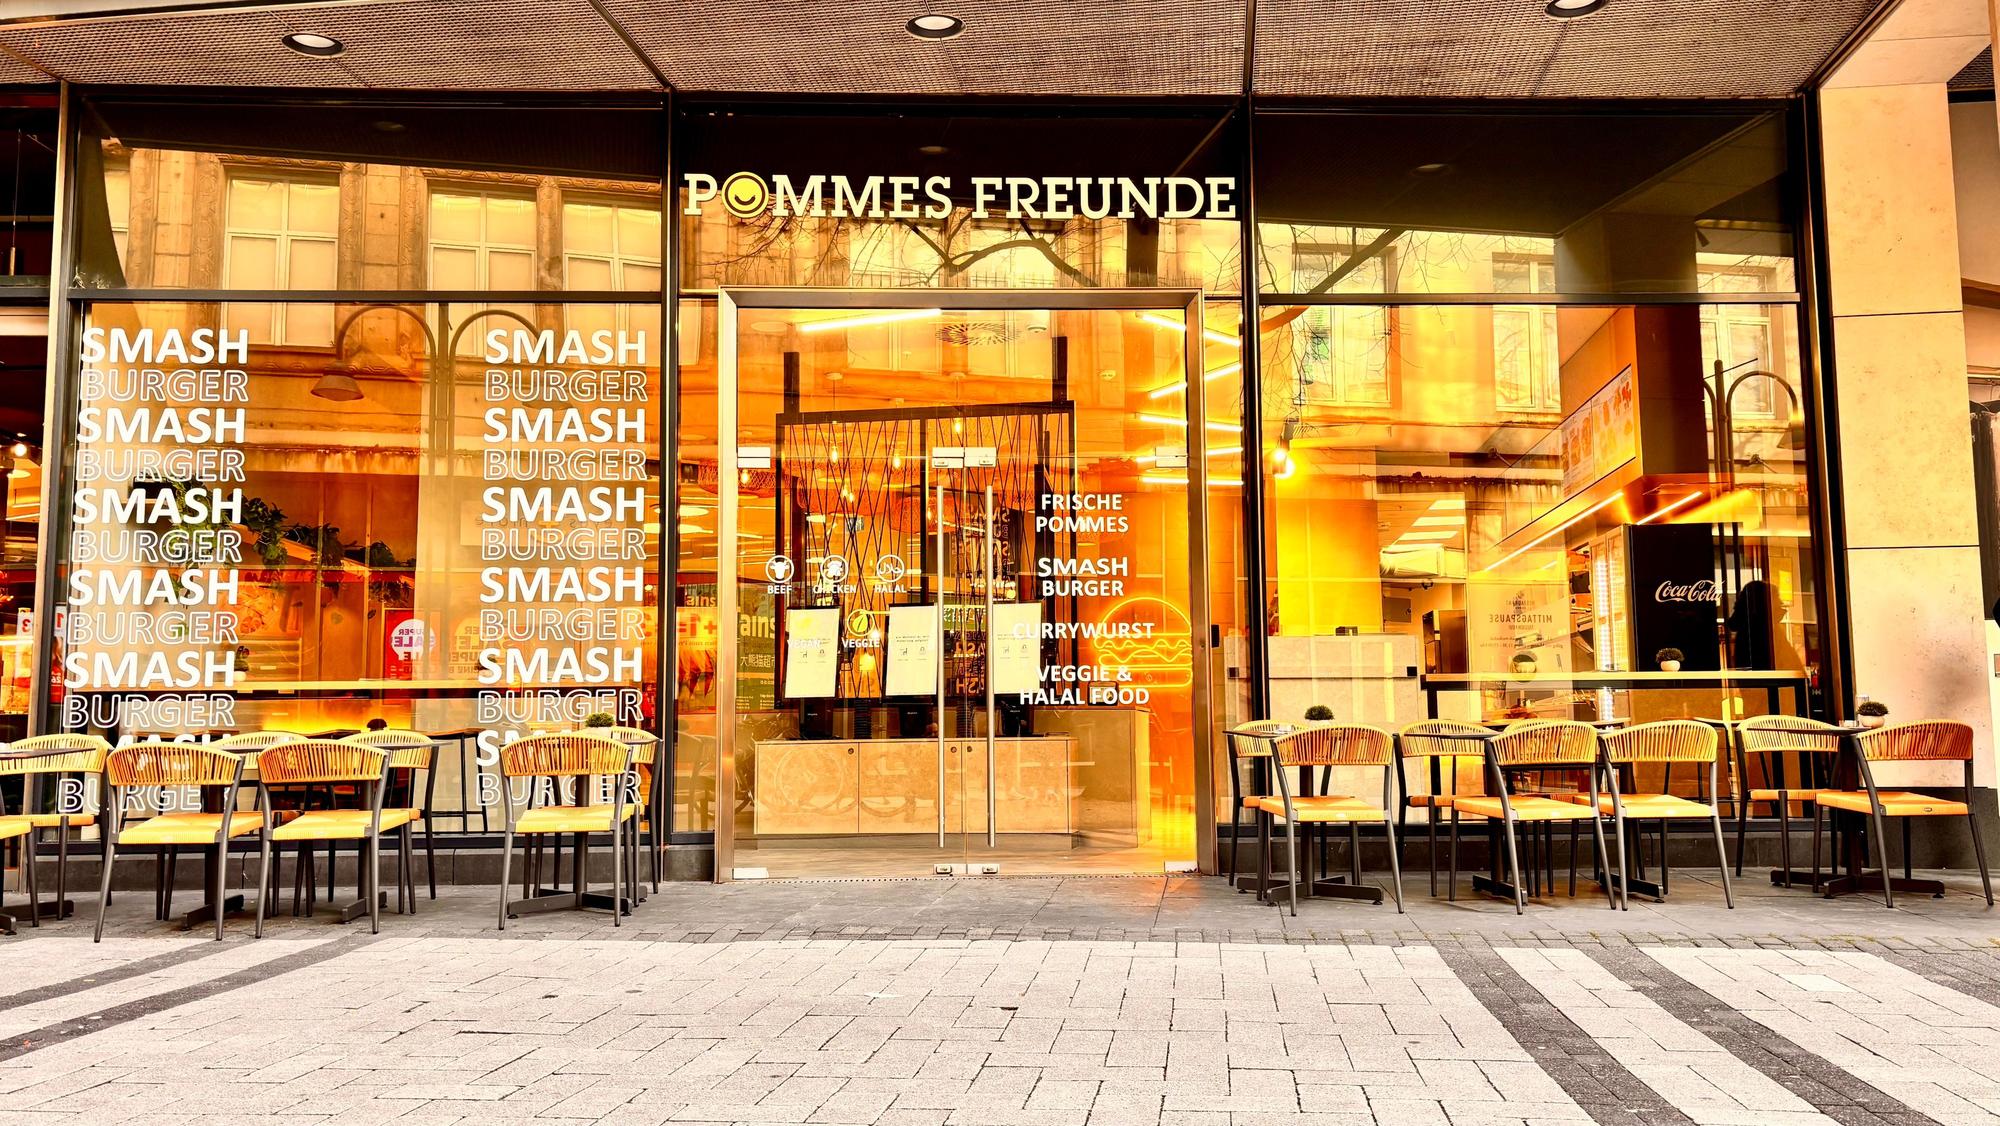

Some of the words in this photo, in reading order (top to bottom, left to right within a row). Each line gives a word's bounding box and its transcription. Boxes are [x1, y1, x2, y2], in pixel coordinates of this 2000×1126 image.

[971, 176, 1237, 220] FREUNDE
[81, 327, 249, 365] SMASH
[485, 328, 646, 365] SMASH
[79, 369, 249, 402] BURGER
[484, 369, 649, 402] BURGER
[76, 407, 246, 444] SMASH
[483, 407, 646, 444] SMASH
[75, 449, 246, 483] BURGER
[483, 448, 648, 482] BURGER
[73, 487, 243, 524] SMASH
[481, 486, 645, 523] SMASH
[1041, 494, 1122, 511] FRISCHE
[1036, 516, 1129, 533] POMMES
[71, 529, 243, 563] BURGER
[481, 527, 647, 561] BURGER
[1038, 557, 1128, 577] SMASH
[68, 568, 239, 606] SMASH
[479, 566, 644, 603] SMASH
[767, 585, 793, 595] BEEF
[813, 584, 857, 594] CHICKEN
[874, 584, 907, 594] HALAL
[1042, 580, 1124, 597] BURGER
[67, 611, 239, 646] BURGER
[479, 607, 646, 642] BURGER
[1012, 622, 1155, 639] CURRYWURST
[842, 637, 880, 648] VEGGIE
[63, 650, 236, 689] SMASH
[477, 646, 643, 685] SMASH
[1036, 665, 1109, 682] VEGGIE
[1116, 665, 1132, 682] &
[62, 693, 236, 729] BURGER
[477, 688, 645, 723] BURGER
[1020, 688, 1085, 705] HALAL
[1091, 688, 1150, 705] FOOD
[58, 778, 231, 813] BURGE
